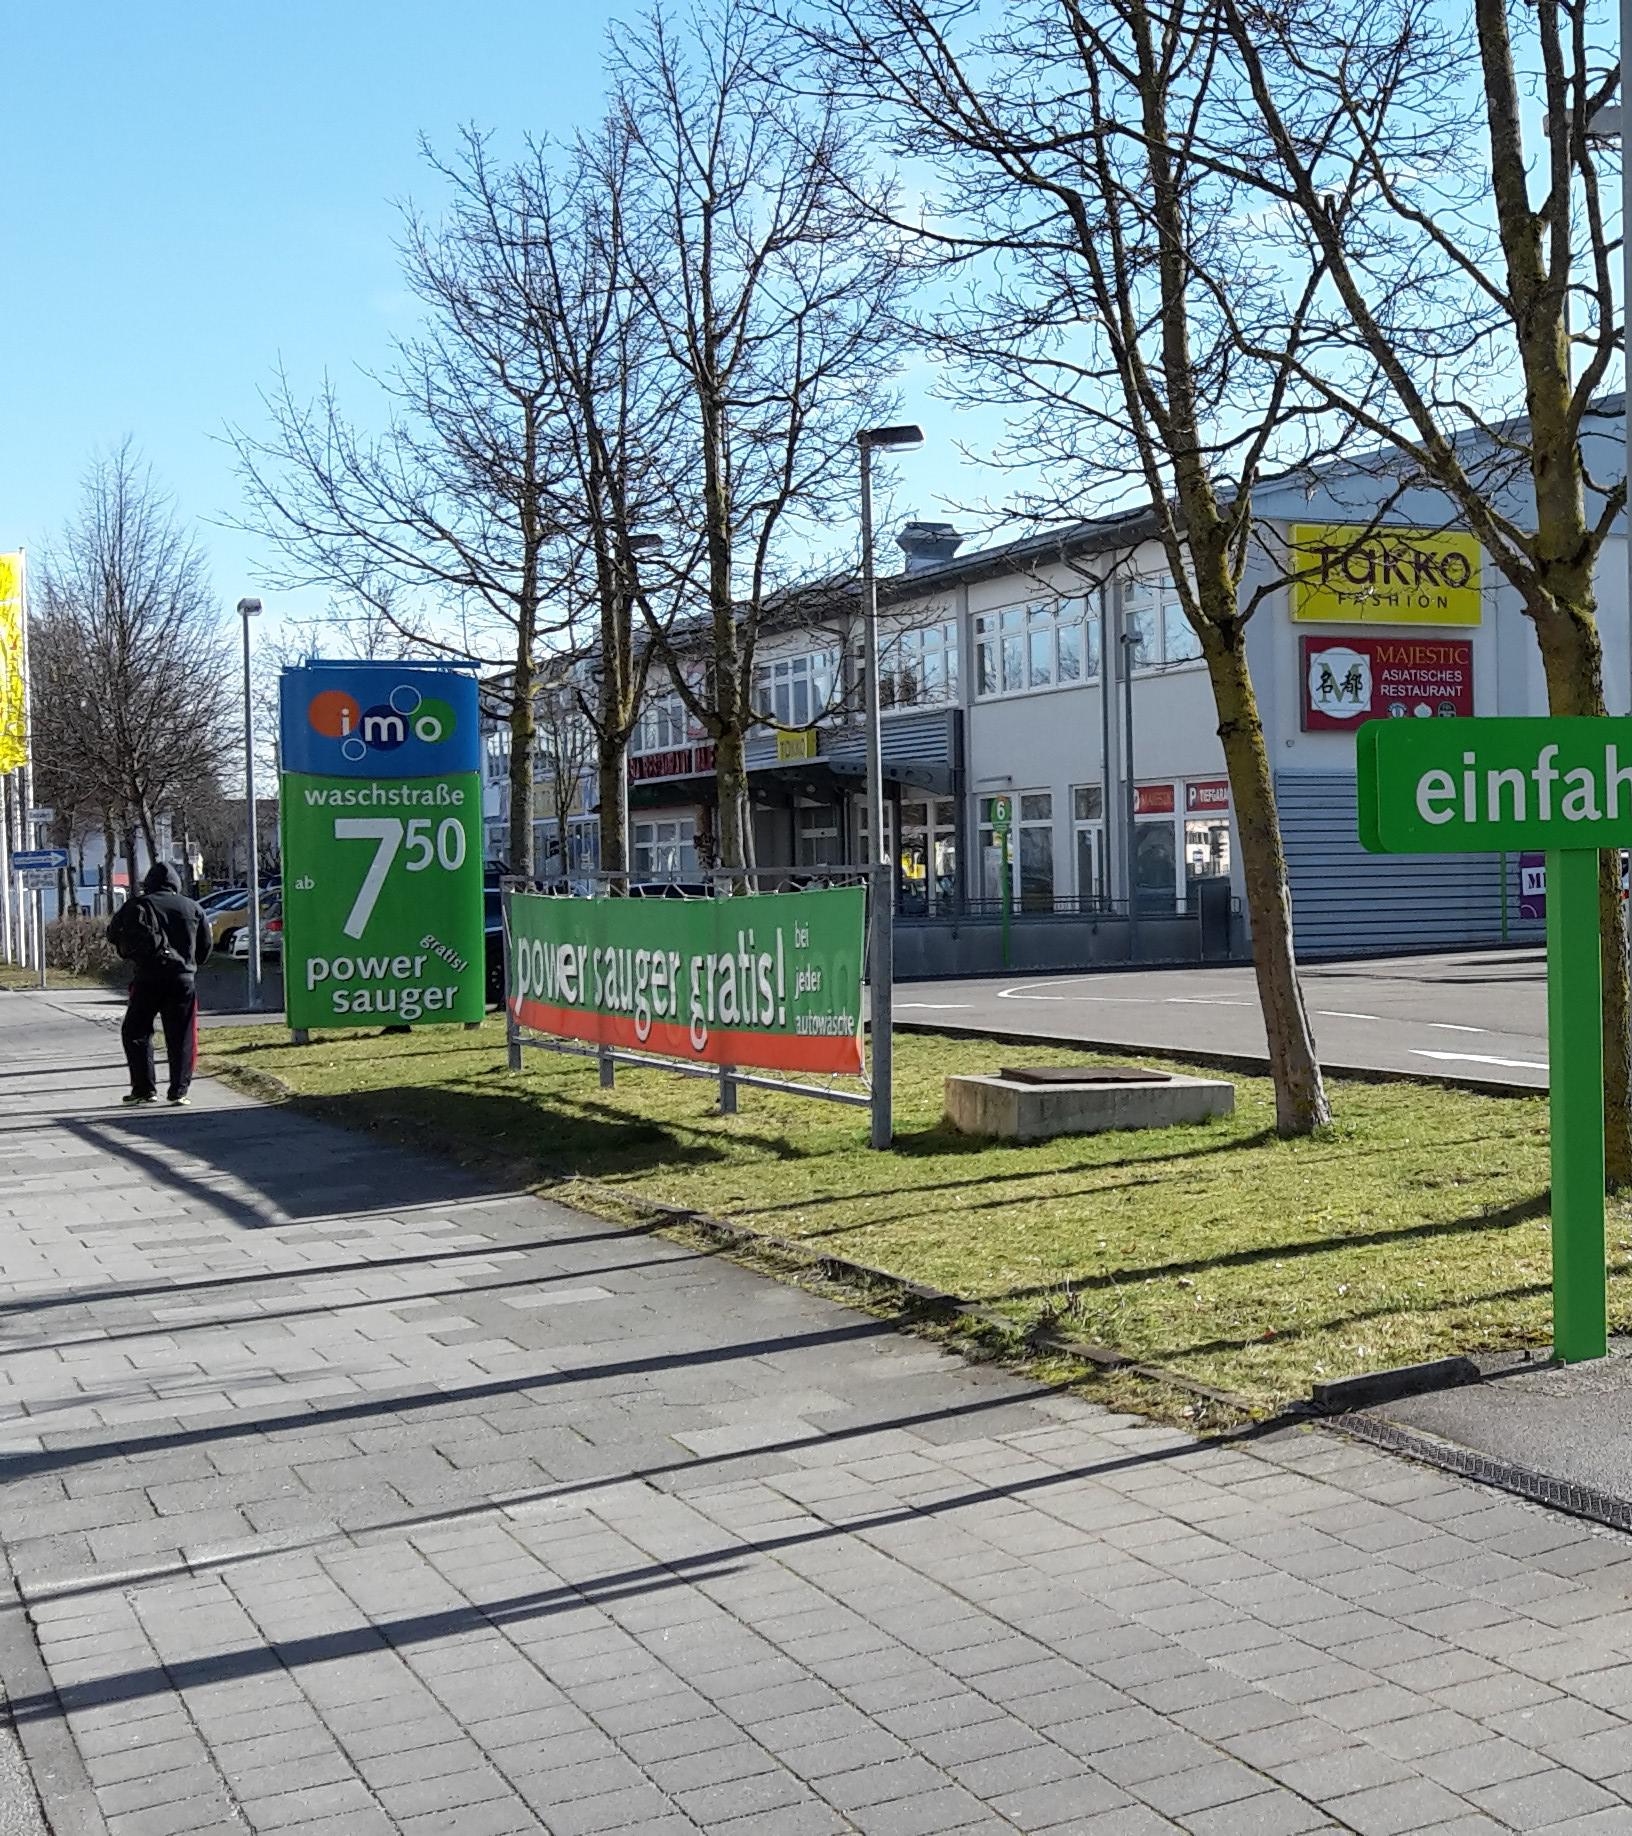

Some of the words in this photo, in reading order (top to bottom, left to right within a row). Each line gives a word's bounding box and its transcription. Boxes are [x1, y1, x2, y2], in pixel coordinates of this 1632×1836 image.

[1338, 593, 1449, 609] FASHION
[1376, 646, 1469, 665] MAJESTIC
[1381, 669, 1463, 682] ASIATISCHES
[1380, 684, 1463, 697] RESTAURANT
[340, 707, 443, 743] imo
[304, 783, 465, 806] waschstraße
[996, 801, 1006, 820] 6
[295, 875, 315, 890] ab
[794, 919, 810, 949] bei
[419, 934, 469, 974] gratis!
[306, 954, 428, 991] power
[794, 963, 822, 1001] jeder
[331, 985, 459, 1021] sauger
[514, 936, 588, 1018] power
[592, 945, 681, 1041] sauger
[689, 927, 786, 1051] gratis!
[794, 1008, 855, 1037] autowäsche
